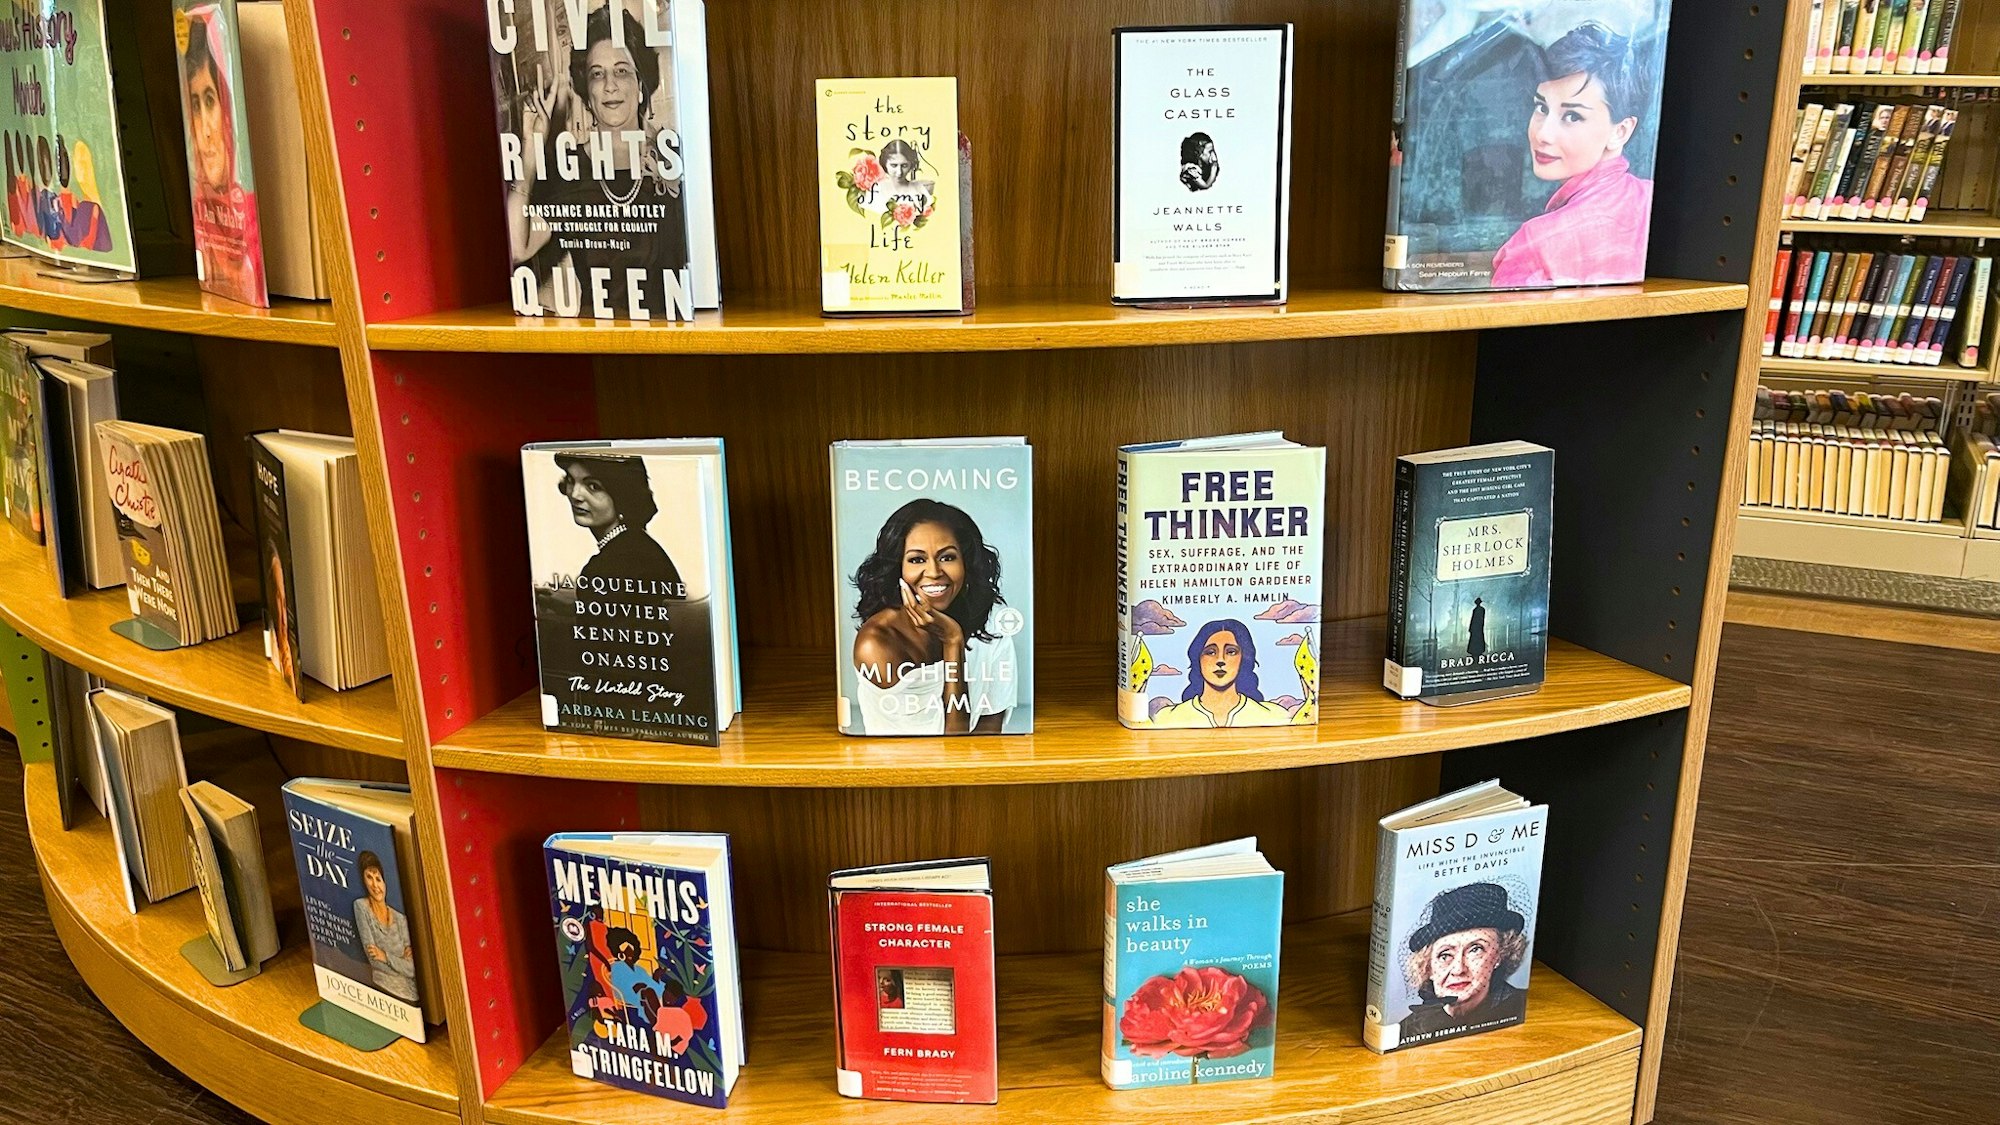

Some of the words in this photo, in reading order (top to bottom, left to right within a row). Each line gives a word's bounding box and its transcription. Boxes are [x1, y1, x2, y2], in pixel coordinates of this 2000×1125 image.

[488, 0, 672, 54] CIVIL
[1187, 68, 1215, 77] THE
[1170, 87, 1231, 98] GLASS
[874, 95, 904, 114] the
[1164, 108, 1236, 120] CASTLE
[845, 114, 930, 151] story
[499, 128, 684, 182] RIGHTS
[857, 182, 879, 205] of
[890, 192, 926, 213] my
[522, 204, 582, 218] CONSTANCE
[585, 204, 619, 218] BAKER
[623, 204, 666, 218] MOTLEY
[1152, 205, 1244, 216] JEANNETTE
[532, 222, 547, 232] AND
[549, 222, 562, 232] THE
[564, 222, 602, 232] STRUGGLE
[604, 222, 619, 232] FOR
[621, 222, 658, 233] EQUALITY
[1173, 222, 1223, 232] WALLS
[870, 224, 914, 251] Life
[840, 262, 890, 284] Helen
[896, 259, 946, 284] Keller
[1438, 270, 1469, 278] Hepburn
[511, 265, 694, 321] QUEEN
[257, 460, 280, 496] HOPE
[845, 467, 1019, 492] BECOMING
[1118, 459, 1127, 515] FREE
[1181, 470, 1274, 503] FREE
[1144, 506, 1308, 541] THINKER
[1468, 524, 1502, 538] MRS.
[1149, 548, 1175, 560] SEX,
[1180, 547, 1246, 559] SUFFRAGE,
[1251, 546, 1276, 556] AND
[1282, 545, 1304, 555] THE
[1443, 537, 1524, 557] SHERLOCK
[1117, 521, 1128, 616] THINKER
[1151, 562, 1249, 574] EXTRAORDINARY
[1255, 561, 1280, 571] LIFE
[1286, 560, 1301, 570] OF
[1452, 554, 1515, 572] HOLMES
[551, 572, 688, 596] JACQUELINE
[1140, 579, 1177, 589] HELEN
[1183, 577, 1243, 587] HAMILTON
[1249, 575, 1312, 586] GARDENER
[1162, 594, 1220, 605] KIMBERLY
[1226, 593, 1238, 603] A.
[1244, 592, 1289, 602] HAMLIN
[575, 600, 670, 621] BOUVIER
[573, 625, 674, 647] KENNEDY
[581, 651, 670, 672] ONASSIS
[1440, 656, 1474, 669] BRAD
[1478, 651, 1515, 665] RICCA
[857, 660, 1014, 684] MICHELLE
[568, 676, 592, 692] The
[594, 678, 643, 696] Untold
[646, 683, 685, 706] Story
[879, 692, 993, 714] OBAMA
[558, 703, 625, 720] ARBARA
[631, 709, 709, 729] LEAMING
[676, 731, 710, 741] AUTHOR
[289, 808, 356, 852] SEIZE
[1406, 836, 1455, 859] MISS
[1465, 832, 1478, 848] D
[1488, 828, 1505, 843] &
[1511, 821, 1540, 840] ME
[316, 841, 335, 860] the
[1418, 862, 1434, 870] LIFE
[1438, 859, 1458, 867] WITH
[1462, 855, 1477, 863] THE
[1480, 846, 1526, 859] INVINCIBLE
[306, 853, 349, 889] DAY
[1434, 865, 1468, 878] BETTE
[1474, 858, 1509, 871] DAVIS
[552, 857, 700, 925] MEMPHIS
[1126, 896, 1161, 913] she
[864, 923, 914, 932] STRONG
[917, 923, 964, 934] FEMALE
[1125, 915, 1182, 932] walks
[1187, 914, 1208, 929] in
[878, 938, 951, 949] CHARACTER
[1126, 936, 1192, 955] beauty
[1188, 956, 1219, 965] Woman's
[1219, 955, 1245, 963] Journey
[1246, 952, 1273, 961] Through
[1242, 961, 1273, 971] POEMS
[326, 975, 363, 1001] JOYCE
[367, 993, 409, 1022] MEYER
[603, 1018, 650, 1053] TARA
[655, 1029, 679, 1060] M.
[1400, 1033, 1433, 1045] ATHRYN
[1434, 1025, 1468, 1038] SERMAK
[883, 1047, 913, 1057] FERN
[916, 1049, 955, 1059] BRADY
[1131, 1067, 1191, 1083] aroline
[1194, 1058, 1266, 1078] kennedy
